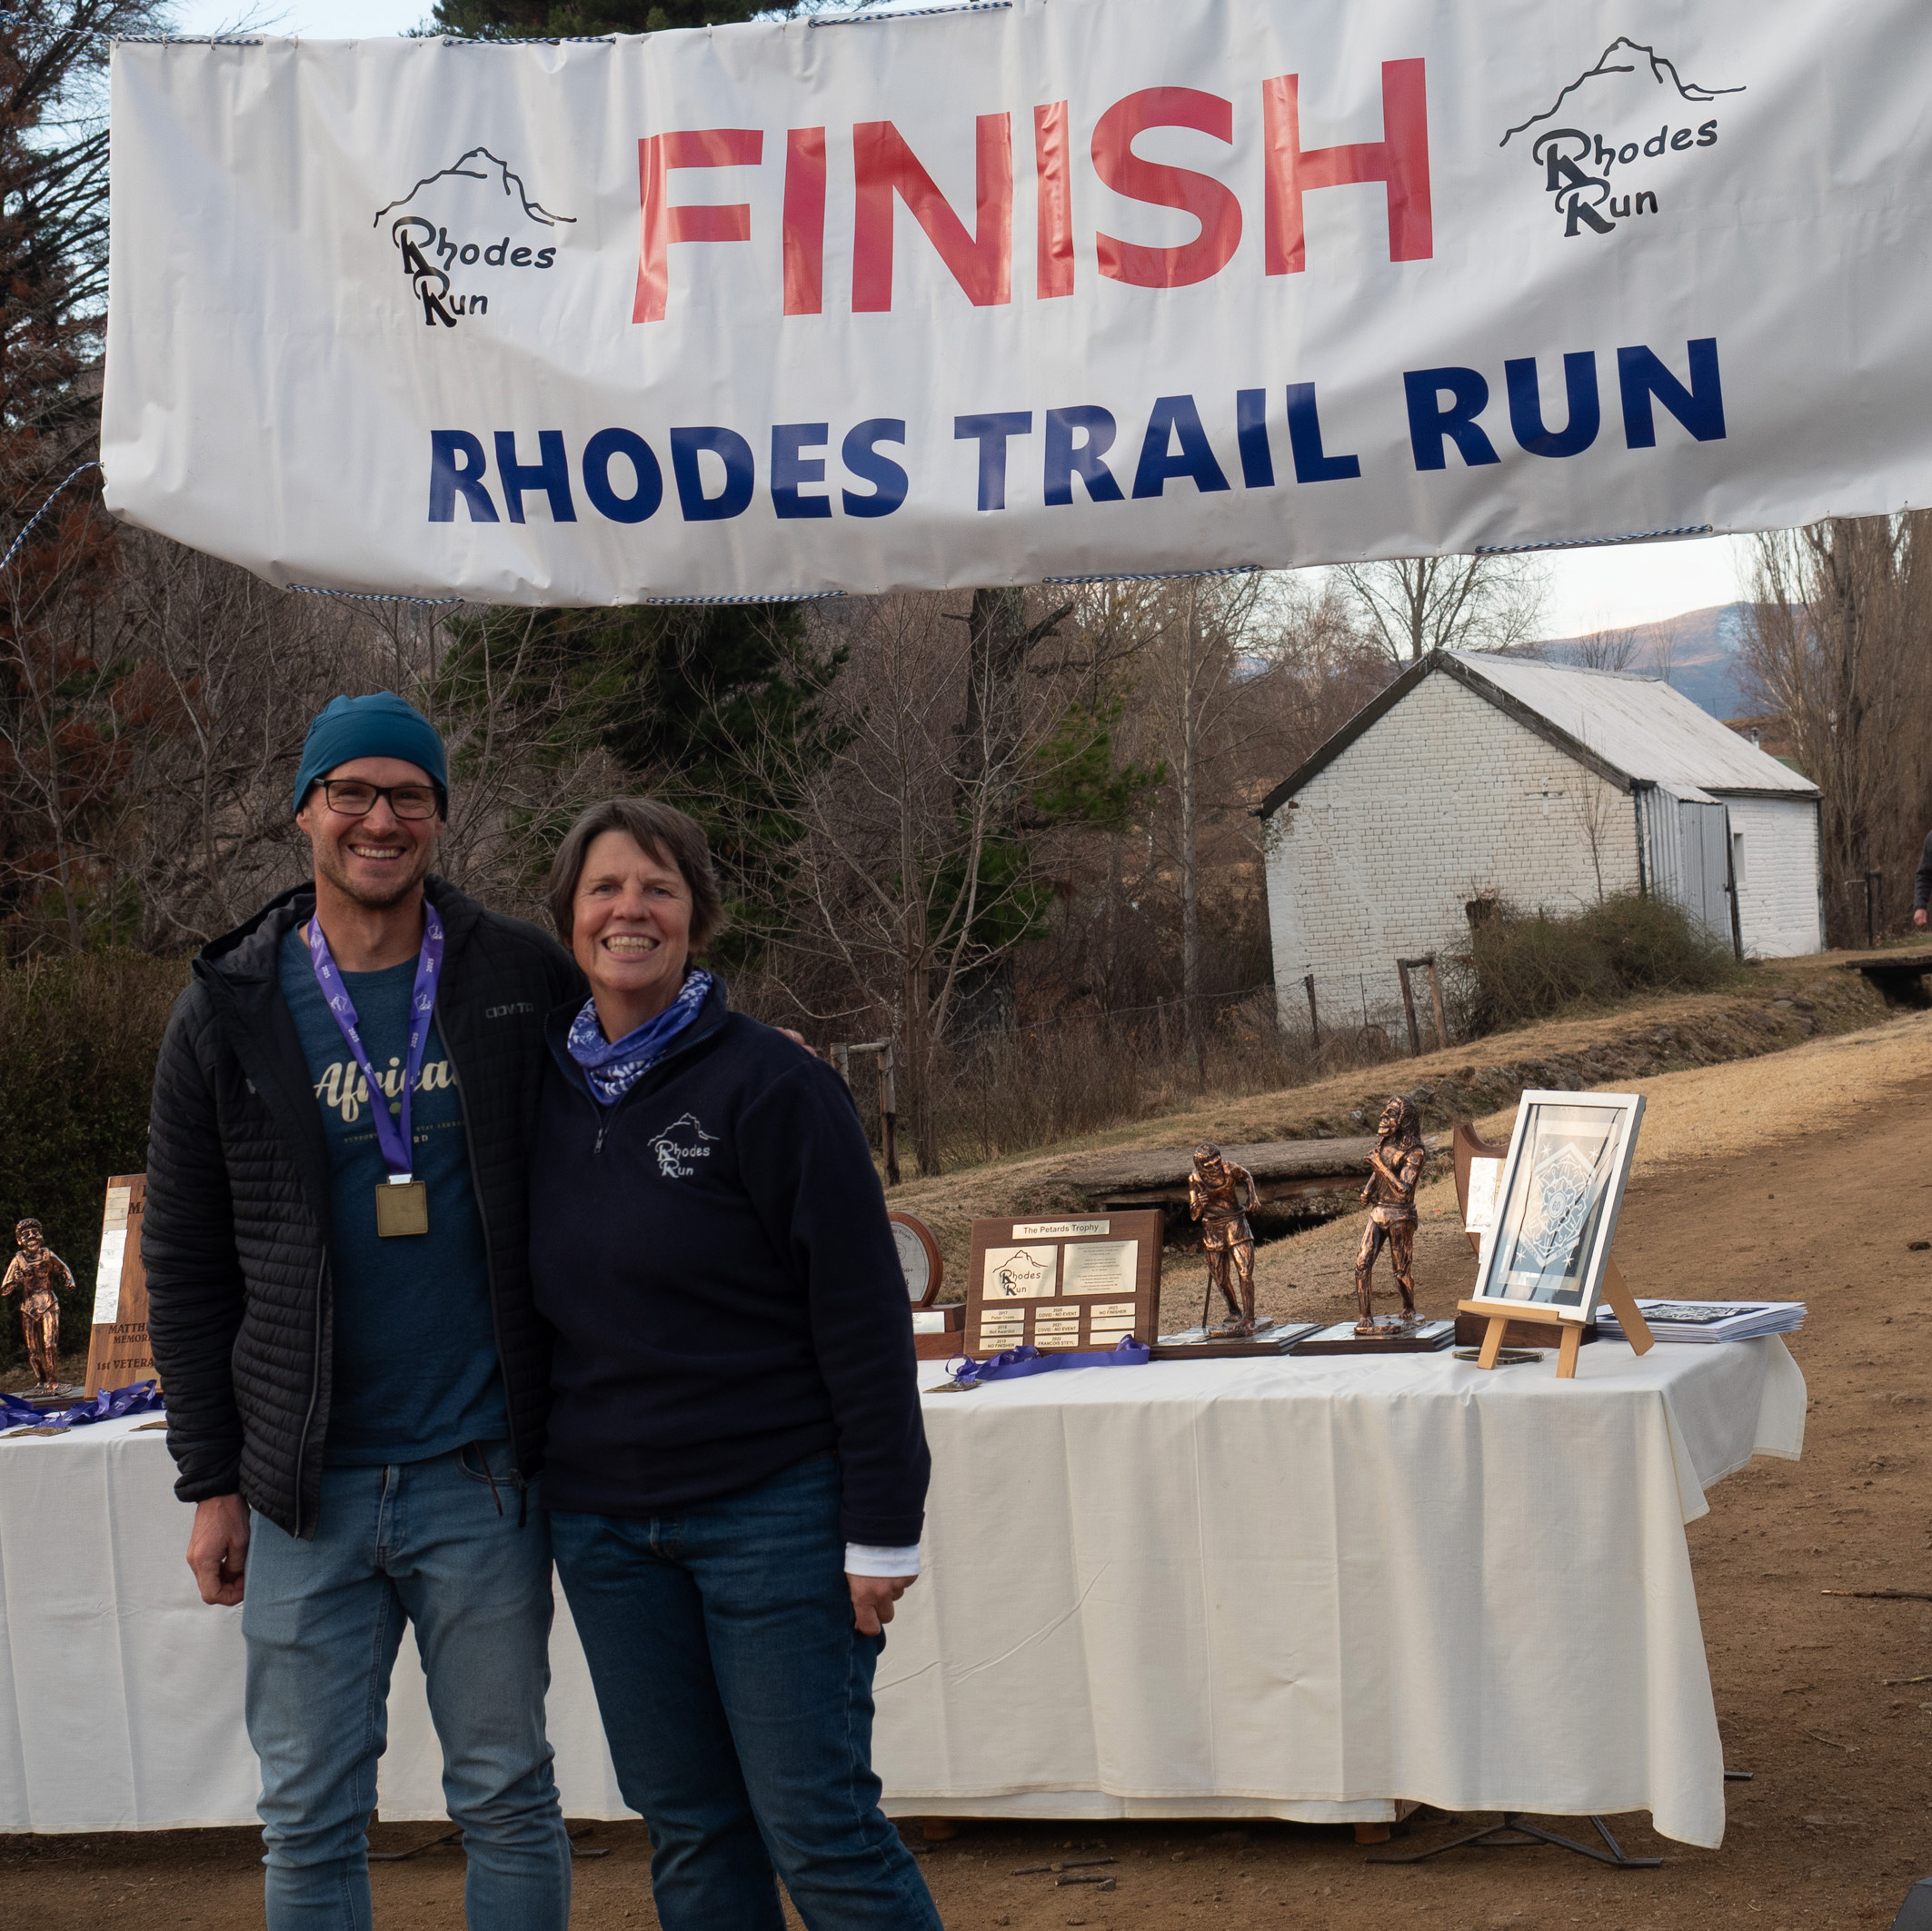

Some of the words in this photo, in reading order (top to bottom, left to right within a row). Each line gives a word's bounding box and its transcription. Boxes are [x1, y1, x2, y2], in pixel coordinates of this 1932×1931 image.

[1532, 119, 1718, 192] Rhodes
[632, 57, 1433, 323] FINISH
[1554, 177, 1658, 237] Run
[392, 215, 557, 274] Rhodes
[413, 266, 488, 328] Run
[428, 418, 910, 524] RHODES
[954, 381, 1362, 512] TRAIL
[1403, 337, 1727, 471] RUN
[348, 1027, 360, 1042] 2025
[411, 1032, 419, 1048] 2025
[314, 1057, 458, 1122] Africa
[654, 1140, 711, 1161] Rhodes
[659, 1157, 693, 1178] Run
[1040, 1225, 1070, 1233] Petards
[1072, 1223, 1100, 1232] Trophy
[1000, 1269, 1041, 1283] Rhodes
[1004, 1281, 1027, 1296] Run
[108, 1322, 148, 1335] MATTH
[113, 1334, 151, 1344] MEMOR
[97, 1361, 111, 1370] 1st
[113, 1357, 154, 1369] VETERA
